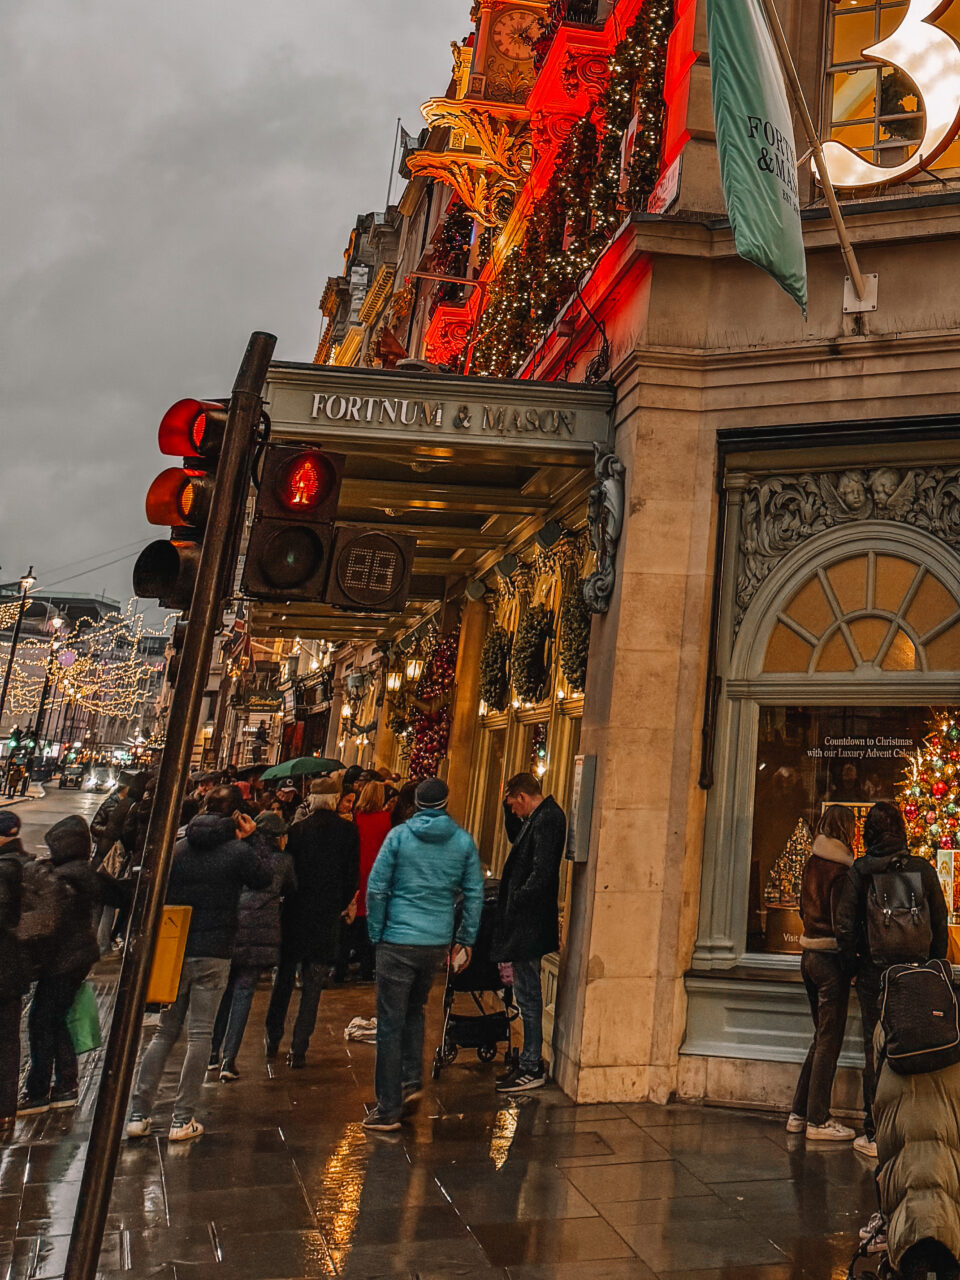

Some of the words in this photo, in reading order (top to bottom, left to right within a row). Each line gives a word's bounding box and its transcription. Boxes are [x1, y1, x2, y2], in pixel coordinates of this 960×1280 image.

[311, 393, 443, 426] FORTNUM
[454, 405, 472, 429] &
[482, 405, 577, 435] MASON
[824, 736, 865, 746] Countdown
[866, 737, 874, 746] to
[875, 736, 913, 746] Christmas
[807, 748, 823, 757] with
[838, 748, 864, 759] Luxury
[865, 748, 892, 757] Advent
[783, 932, 799, 942] Visit
